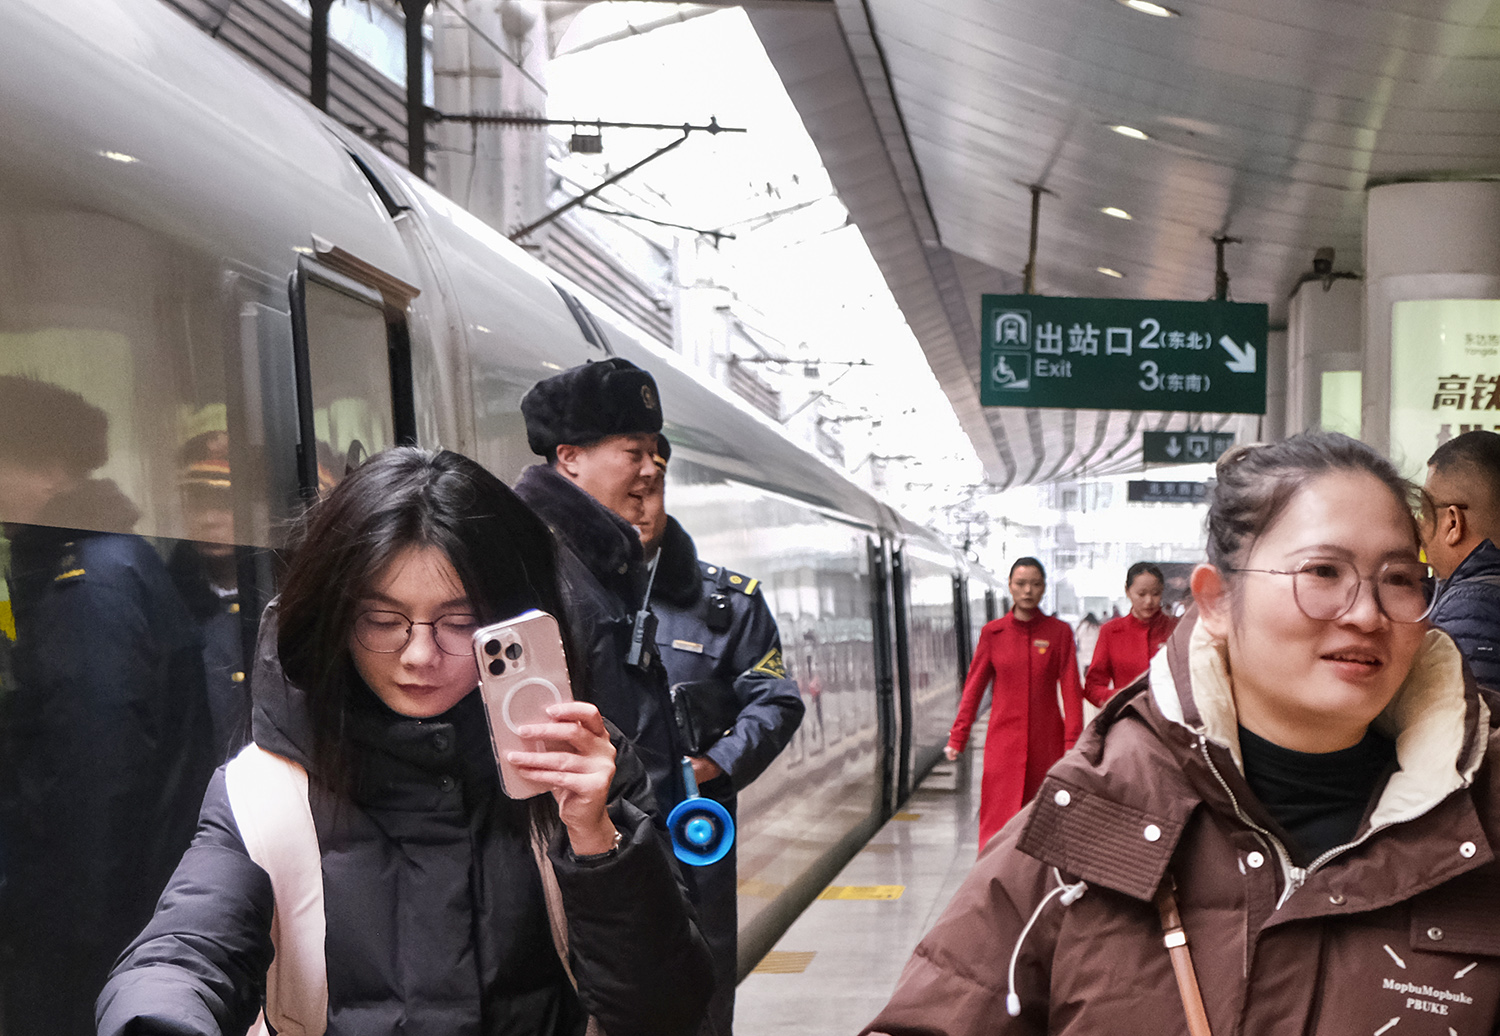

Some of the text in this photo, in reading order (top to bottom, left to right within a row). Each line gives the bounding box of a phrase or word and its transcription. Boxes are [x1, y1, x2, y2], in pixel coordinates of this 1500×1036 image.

[1035, 321, 1133, 357] 出站口
[1035, 359, 1072, 378] Exit
[1382, 977, 1474, 1005] MopbuMopbuke
[1405, 997, 1449, 1016] PBUKE
